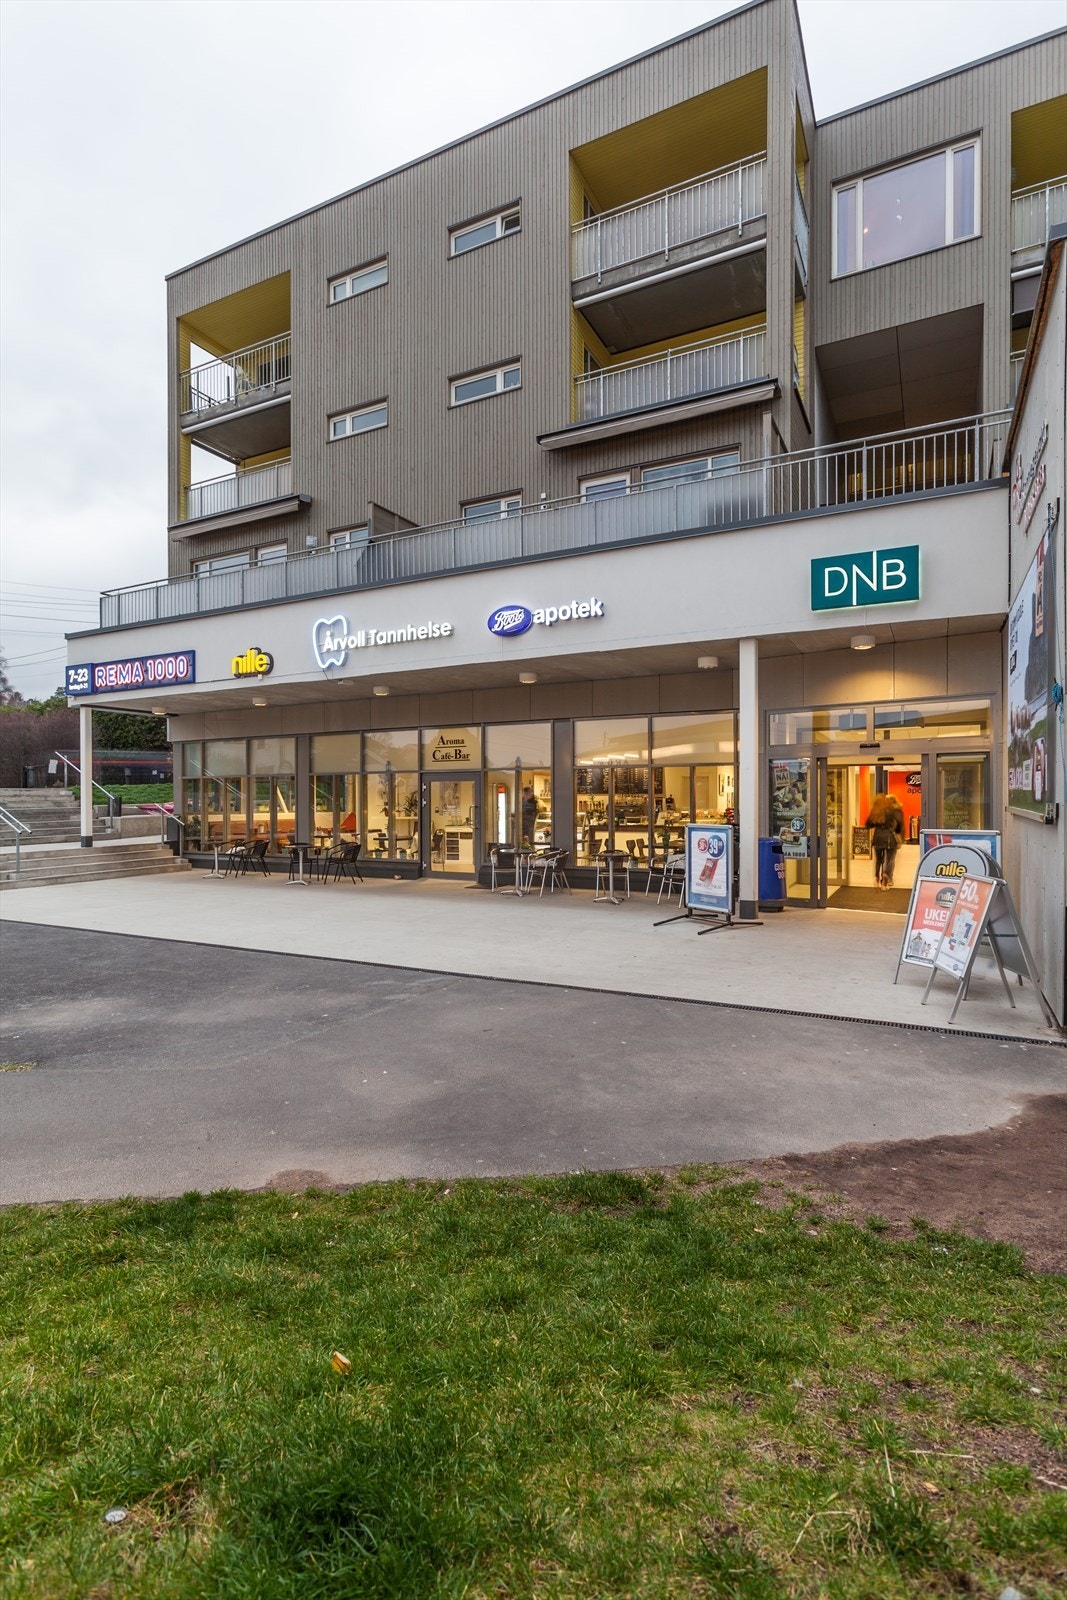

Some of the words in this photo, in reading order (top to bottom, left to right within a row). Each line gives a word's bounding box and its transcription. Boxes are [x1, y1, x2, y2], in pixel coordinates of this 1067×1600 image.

[824, 550, 907, 606] DNB
[491, 609, 525, 632] Boots
[533, 597, 603, 626] apotek
[323, 630, 366, 653] Årvoll
[369, 620, 452, 646] Tannhelse
[94, 661, 144, 687] REMA
[147, 655, 189, 681] 1000
[231, 647, 270, 676] nille
[69, 668, 88, 683] 7-23
[437, 735, 465, 746] Aroma
[432, 748, 470, 761] Café-Bar
[937, 862, 966, 876] nille
[938, 890, 955, 901] nille
